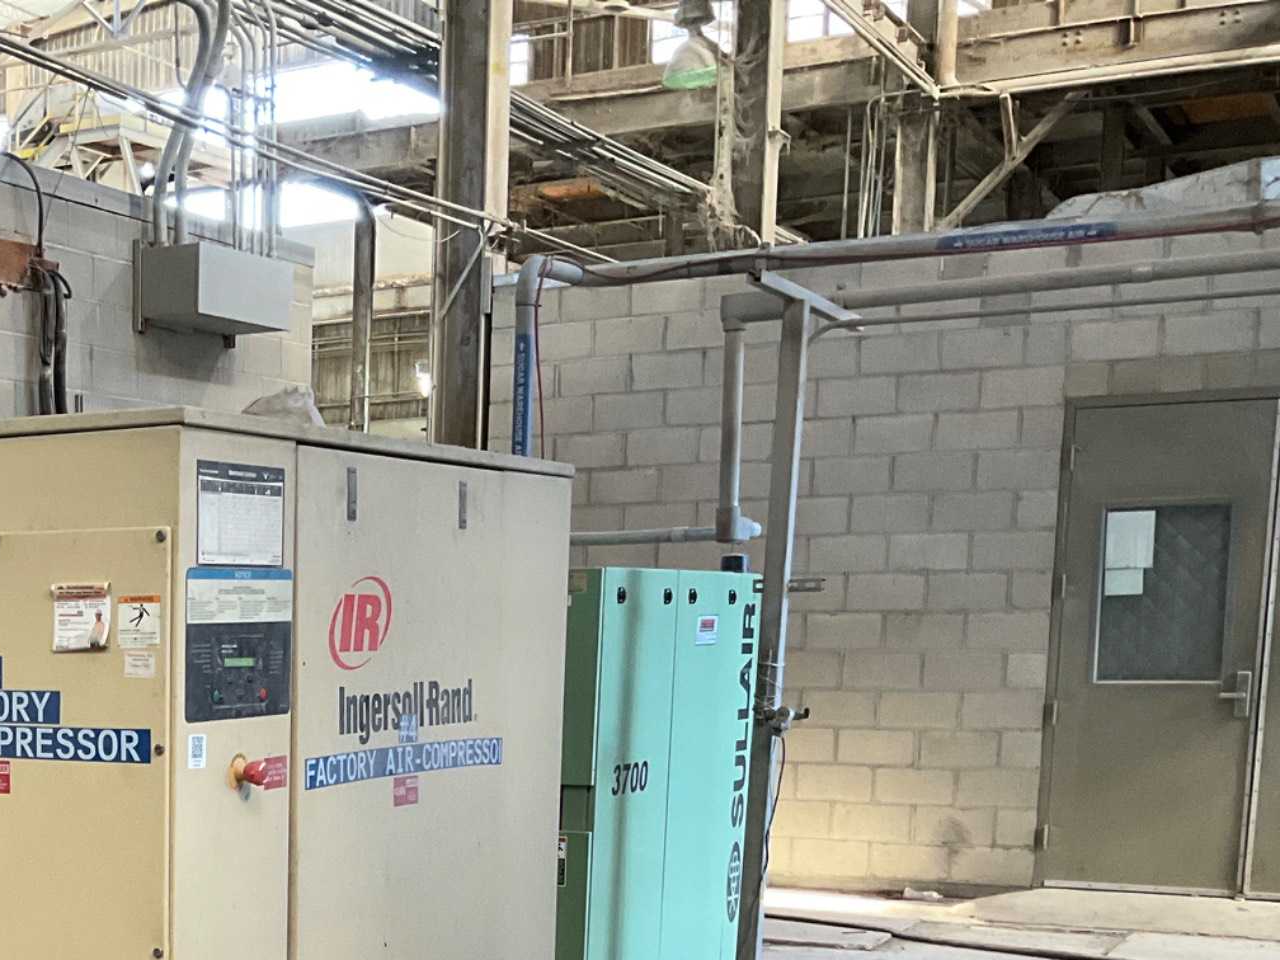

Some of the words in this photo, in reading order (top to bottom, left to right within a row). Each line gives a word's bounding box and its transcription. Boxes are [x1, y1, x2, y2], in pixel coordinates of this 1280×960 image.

[339, 594, 382, 652] IR
[400, 714, 417, 742] #4
[731, 603, 756, 828] SULLAIR
[306, 750, 380, 788] FACTORY
[385, 738, 502, 775] AIR-COMPRESSO
[612, 760, 649, 796] 3700
